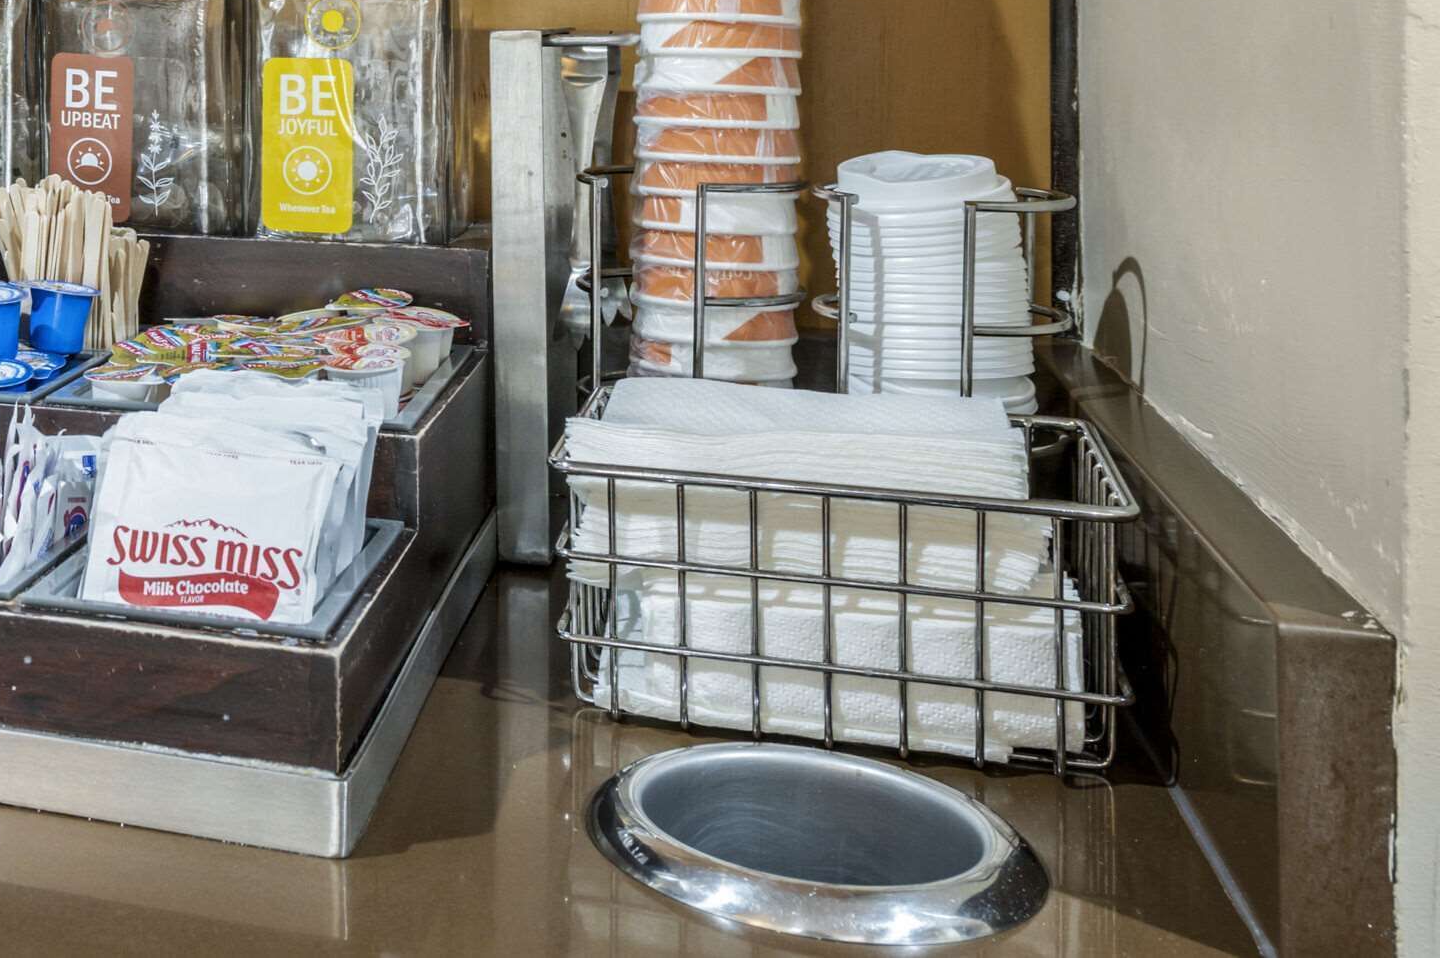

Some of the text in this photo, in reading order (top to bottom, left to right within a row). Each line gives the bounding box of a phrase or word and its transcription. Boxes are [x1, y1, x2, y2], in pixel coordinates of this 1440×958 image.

[65, 68, 118, 111] BE
[279, 74, 336, 117] BE
[61, 110, 121, 130] UPBEAT
[278, 117, 338, 137] JOYFUL
[106, 194, 120, 204] Tea
[143, 578, 249, 596] Milk Chocolate
[180, 595, 204, 604] FLAVOR
